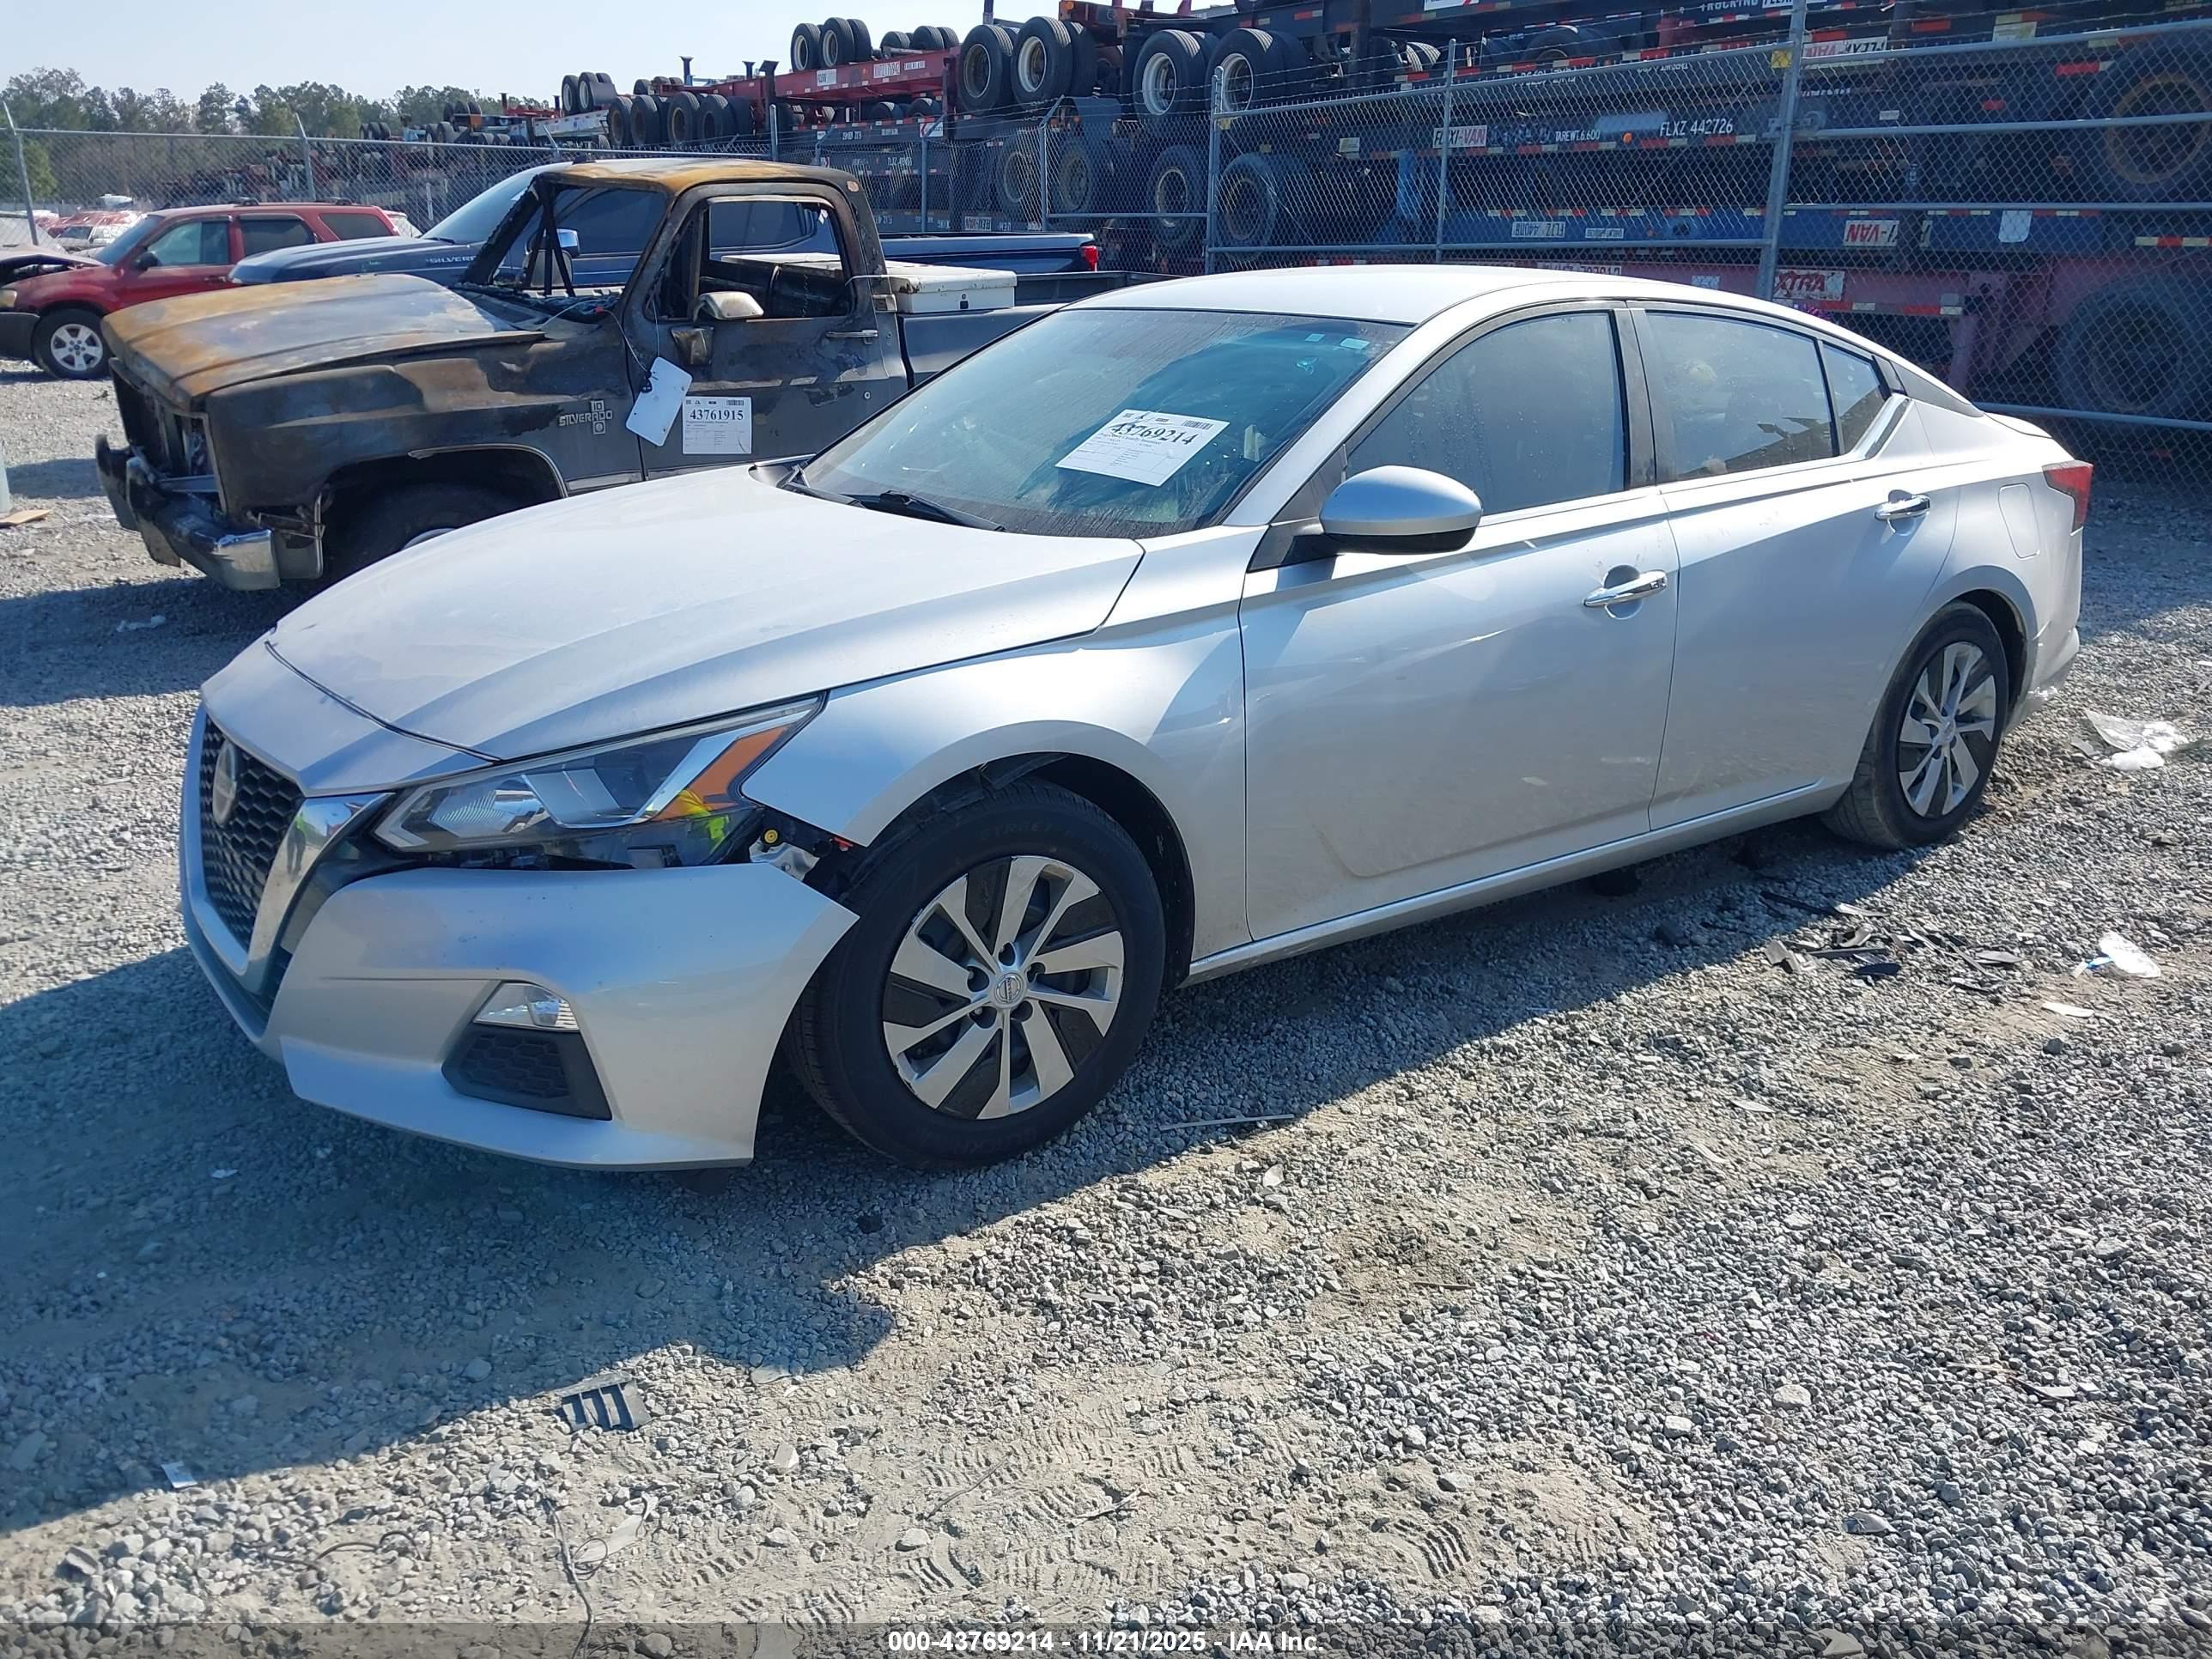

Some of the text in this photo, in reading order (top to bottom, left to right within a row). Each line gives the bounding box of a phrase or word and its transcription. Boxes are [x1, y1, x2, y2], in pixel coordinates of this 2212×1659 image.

[1433, 128, 1486, 145] FLXI-VAN
[1659, 120, 1686, 137] FLXZ
[1690, 118, 1734, 135] 442726
[559, 410, 613, 427] SILVERADO
[690, 409, 744, 421] 43761915
[1112, 422, 1200, 446] 43769214
